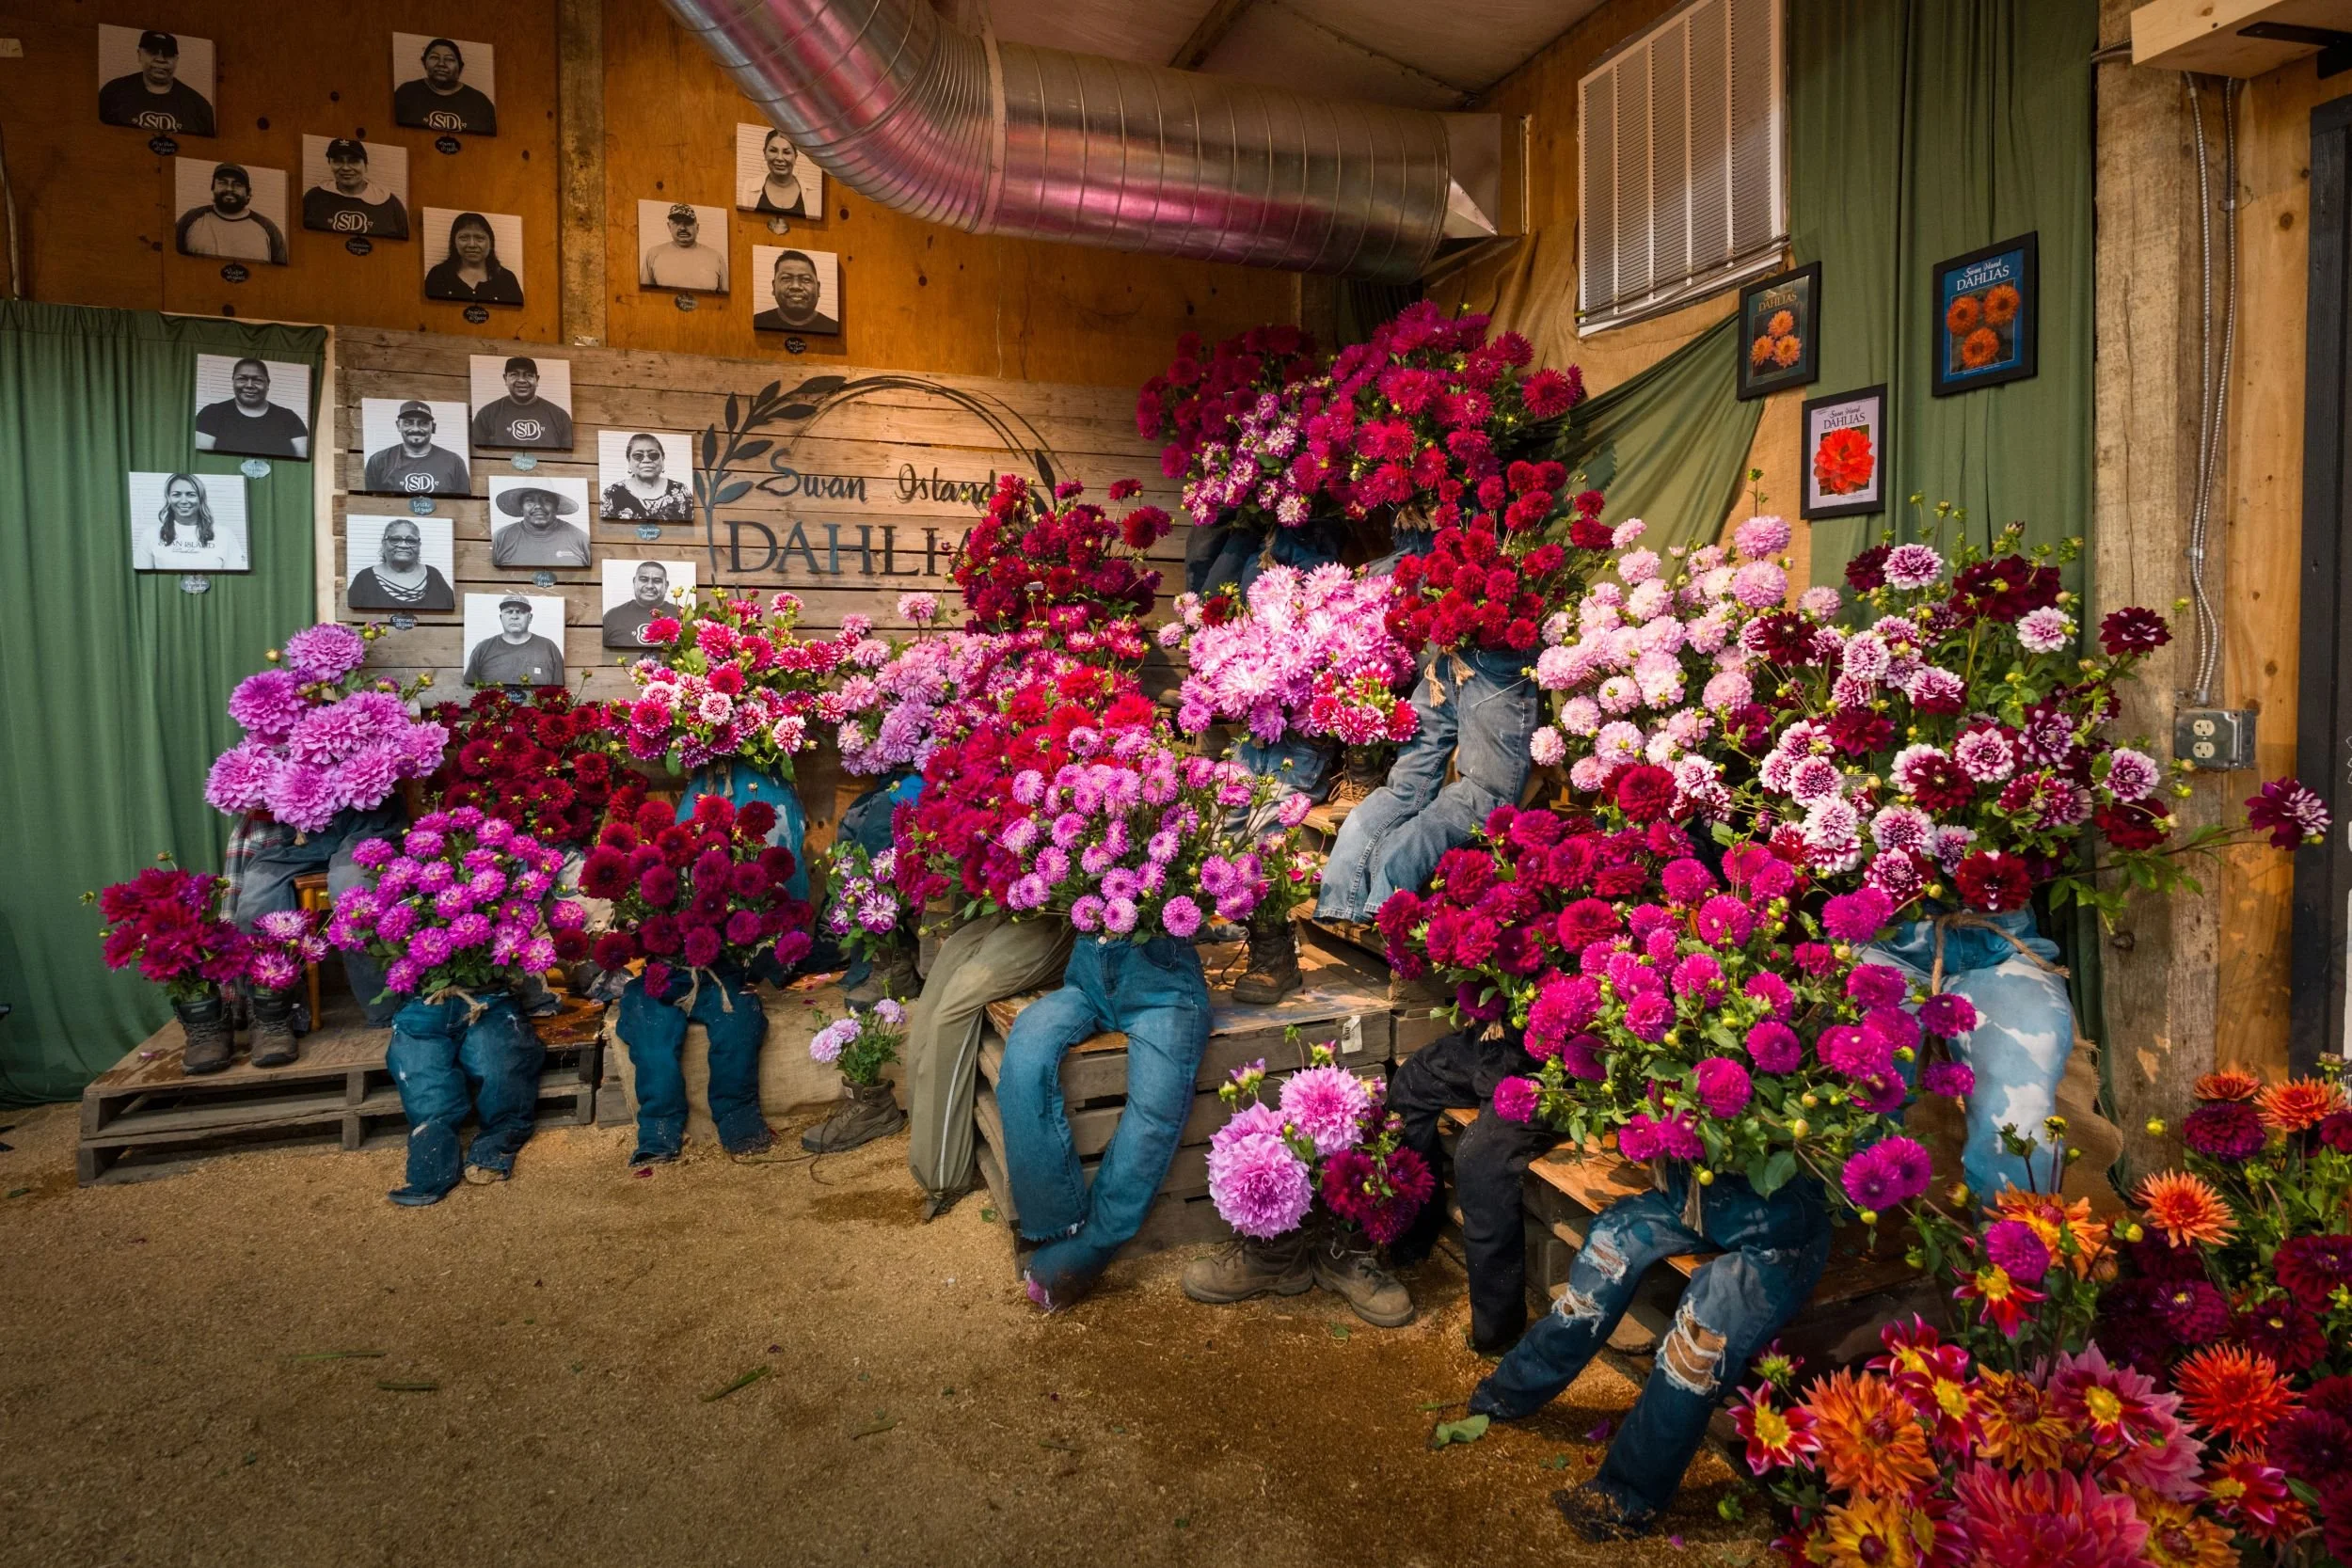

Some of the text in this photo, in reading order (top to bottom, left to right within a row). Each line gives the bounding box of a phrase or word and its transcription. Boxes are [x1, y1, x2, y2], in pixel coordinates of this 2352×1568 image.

[144, 115, 172, 130] SD
[433, 114, 457, 129] SD
[337, 214, 363, 231] SD
[1963, 258, 2002, 277] Swan Island
[1957, 265, 2010, 292] DAHLIAS
[1758, 293, 1798, 312] DAHLIAS
[1830, 410, 1844, 419] Swan
[1845, 405, 1861, 415] Island
[1823, 413, 1866, 429] DAHLIAS
[516, 422, 537, 437] SD
[408, 475, 431, 491] SD
[755, 447, 996, 505] Swan Island
